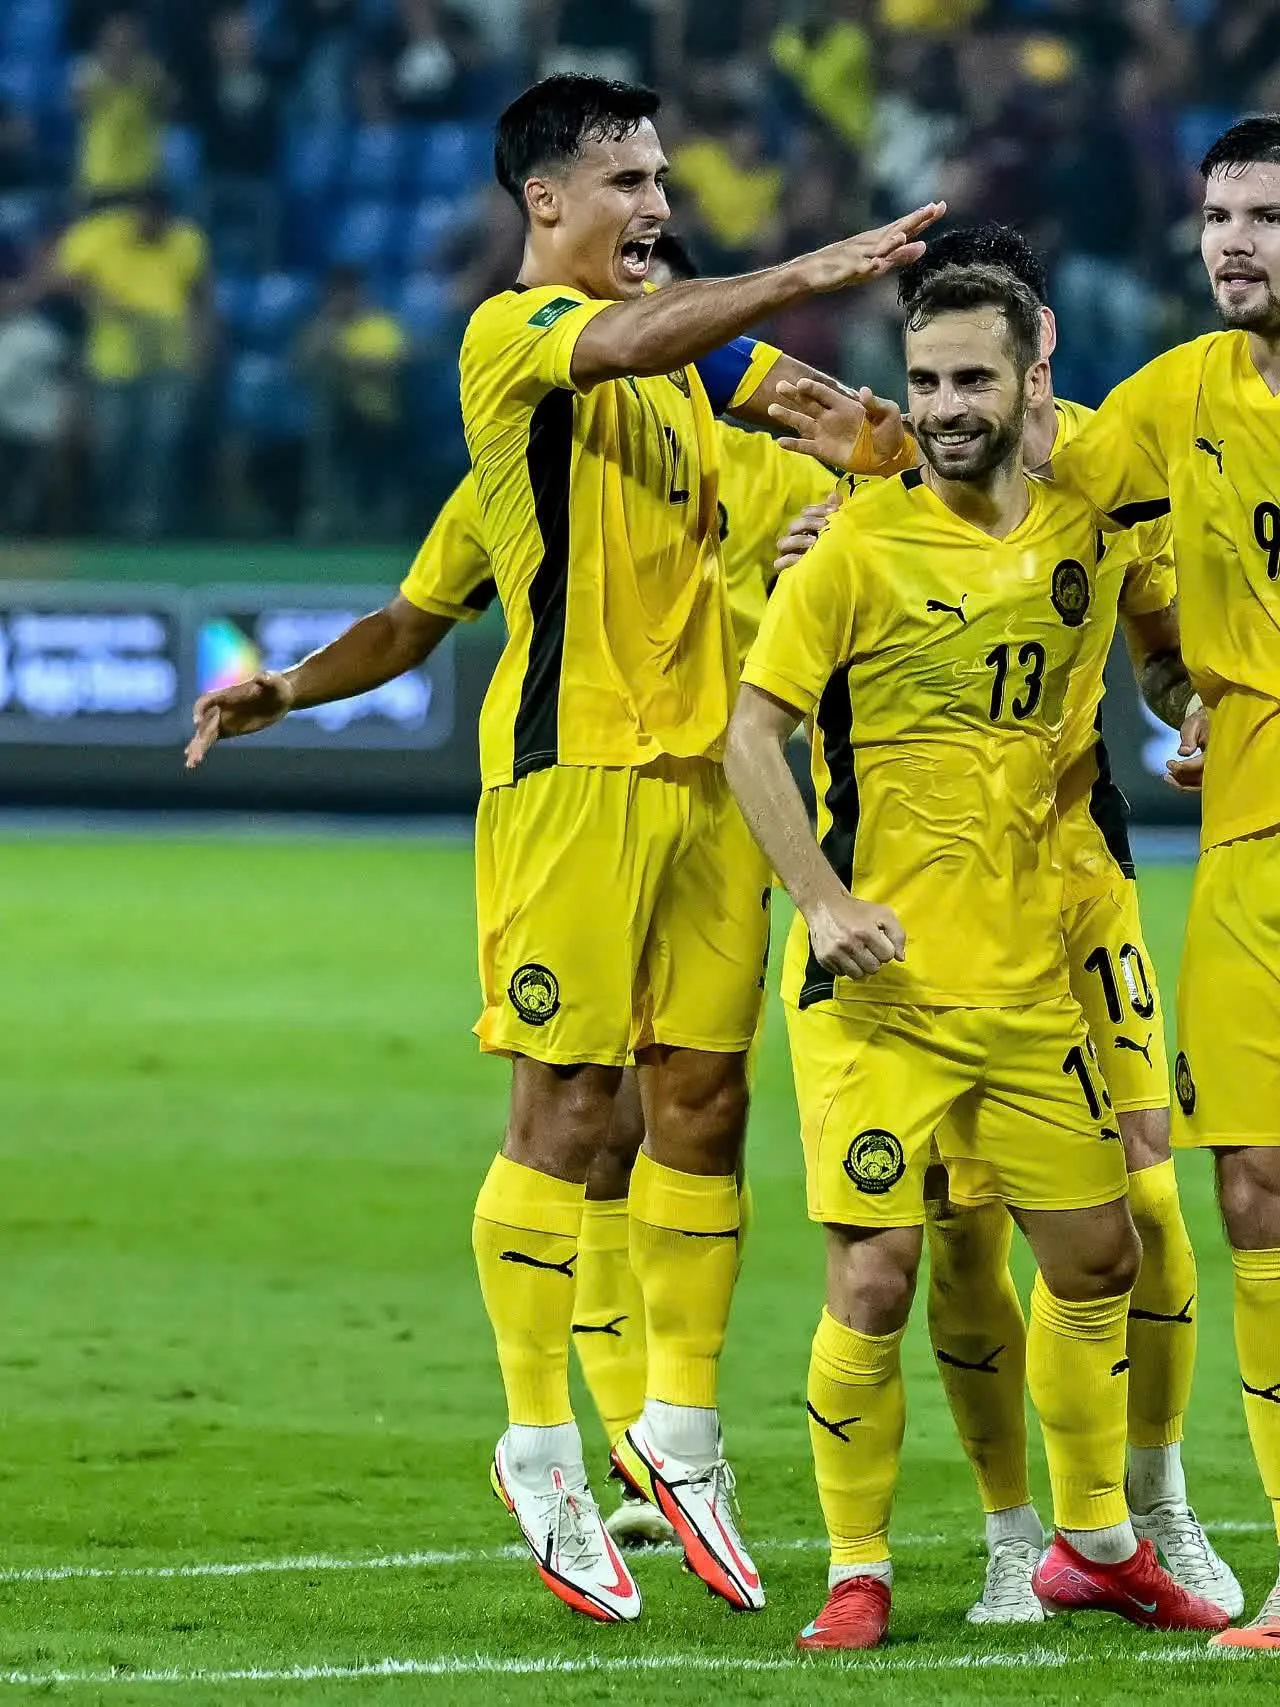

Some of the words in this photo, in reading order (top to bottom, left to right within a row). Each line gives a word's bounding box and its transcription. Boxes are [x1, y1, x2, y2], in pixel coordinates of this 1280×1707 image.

[985, 641, 1046, 722] 13
[1083, 942, 1155, 1024] 10
[1062, 1034, 1112, 1121] 1
